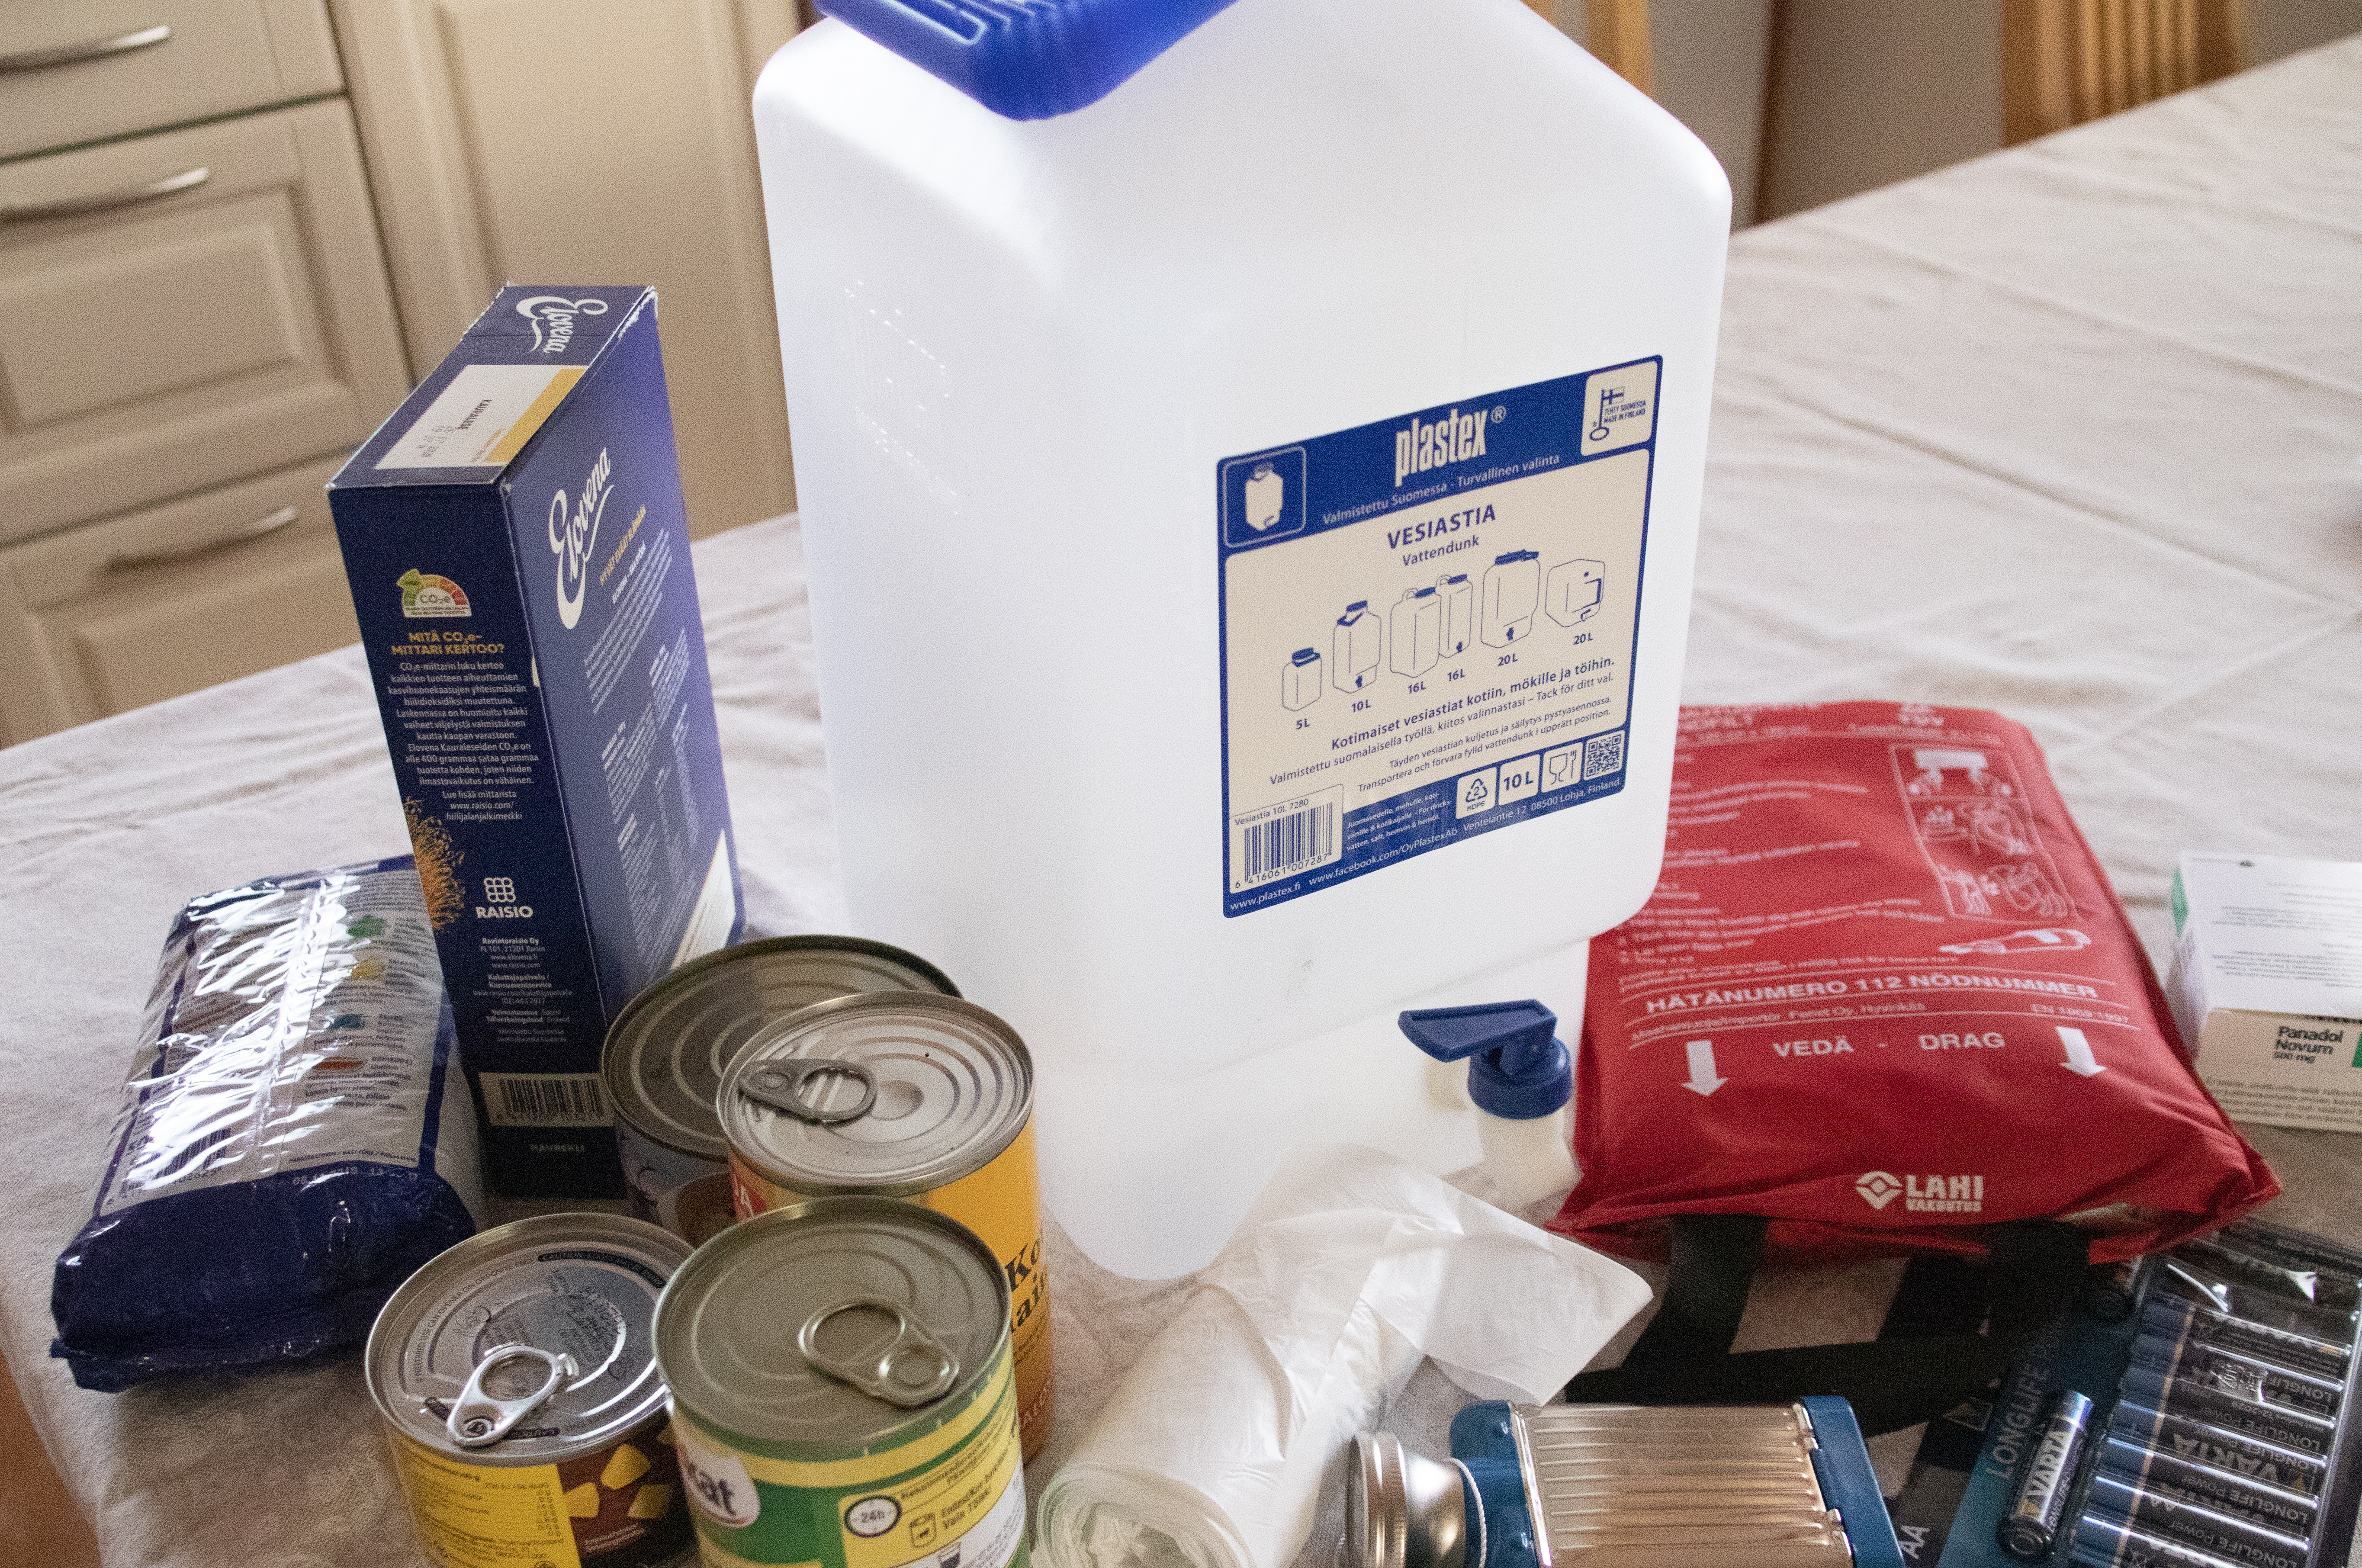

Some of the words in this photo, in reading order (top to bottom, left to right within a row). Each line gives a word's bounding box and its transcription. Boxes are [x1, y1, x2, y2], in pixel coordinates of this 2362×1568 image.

[1604, 415, 1617, 423] MADE
[1625, 408, 1645, 419] FINLAND
[1394, 408, 1488, 488] plastex
[1323, 498, 1388, 524] Valmistettu
[1391, 482, 1447, 505] Suomessa
[1457, 463, 1519, 488] Turvallinen
[1522, 453, 1560, 472] valinta
[1387, 504, 1496, 549] VESIASTIA
[1402, 535, 1479, 566] Vattendunk
[409, 630, 440, 643] MITÄ
[392, 644, 442, 655] MITTARI
[445, 644, 504, 655] KERTOO?
[457, 662, 475, 670] luku
[478, 662, 504, 670] kertoo
[391, 674, 424, 683] kaikkien
[426, 674, 461, 682] tuotteen
[464, 674, 518, 682] aiheuttamien
[388, 685, 469, 696] kasvihuonekaasujen
[472, 684, 526, 696] yhteismäärän
[404, 697, 463, 706] hiilidioksidiksi
[465, 697, 515, 705] muutettuna.
[1332, 720, 1400, 749] Kotimaiset
[1404, 699, 1463, 725] vesiastiat
[1467, 685, 1506, 706] kotiin,
[1510, 671, 1557, 693] mökille
[1559, 666, 1571, 682] ja
[1575, 654, 1615, 675] töihin.
[397, 709, 446, 718] Laskennassa
[460, 709, 501, 717] huomioitu
[504, 708, 527, 716] kaikki
[404, 720, 433, 729] vaiheet
[435, 720, 470, 730] viljelystä
[472, 720, 526, 728] valmistuksen
[1270, 759, 1330, 784] Valmistettu
[1334, 736, 1401, 765] suomalaisella
[1405, 725, 1435, 742] työllä,
[1438, 716, 1465, 730] kiitos
[1467, 697, 1525, 721] valinnastasi
[1536, 686, 1558, 702] Tack
[1560, 682, 1574, 695] för
[1577, 676, 1594, 691] ditt
[1597, 671, 1613, 685] val.
[1389, 753, 1419, 769] Täyden
[1422, 739, 1463, 757] vesiastian
[1465, 728, 1498, 744] kuljetus
[1501, 724, 1508, 735] ja
[1510, 715, 1542, 730] säilytys
[1544, 695, 1612, 722] pystyasennossa.
[417, 732, 442, 740] kautta
[444, 732, 473, 742] kaupan
[408, 743, 439, 752] Elovena
[441, 743, 497, 751] Kauraleseiden
[1358, 768, 1412, 792] Transportera
[1414, 761, 1430, 773] och
[1432, 752, 1462, 767] förvara
[1464, 744, 1483, 759] fylld
[1485, 729, 1533, 750] vattendunk
[1540, 719, 1572, 735] upprätt
[1574, 708, 1610, 725] position.
[439, 756, 476, 765] grammaa
[501, 755, 539, 764] grammaa
[450, 766, 482, 774] kohden,
[484, 766, 504, 774] joten
[420, 777, 482, 785] ilmastovaikutus
[495, 776, 534, 784] vähäinen.
[450, 801, 514, 810] www.raisio.com/
[1234, 810, 1270, 826] Vesiastia
[1273, 804, 1287, 816] 10L
[1289, 797, 1309, 810] 7280
[1467, 800, 1485, 812] HDPE
[1230, 882, 1300, 911] www.plastex.fi
[1309, 828, 1458, 885] www.facebook.com/OyPlastexAb
[1463, 810, 1514, 831] Ventelantie
[1516, 805, 1526, 816] 12
[1530, 797, 1558, 810] 08500
[1560, 787, 1586, 804] Lohja,
[1588, 778, 1621, 794] Finland.
[1235, 880, 1240, 889] 6
[1249, 868, 1286, 884] 416061
[1291, 855, 1327, 871] 007287
[476, 906, 533, 919] RAISIO
[1646, 980, 1848, 1013] HÄTÄNUMERO
[1855, 976, 1902, 991] 112
[1909, 973, 2098, 997] NÖDNUMMER
[2031, 1003, 2054, 1014] EN
[2278, 1025, 2343, 1042] Panadol
[1773, 1036, 1854, 1057] VEDÄ
[1919, 1032, 2005, 1050] DRAG
[2275, 1039, 2333, 1054] Novum
[2274, 1051, 2292, 1060] 500
[2296, 1054, 2315, 1064] mg
[1983, 1363, 2051, 1481] LONGLIFE
[2243, 1418, 2321, 1452] LONGLIFE
[2025, 1426, 2073, 1502] VARTA
[2169, 1433, 2282, 1483] VARTA
[2180, 1473, 2227, 1497] Power
[2228, 1490, 2308, 1523] LONGLIFE
[2167, 1520, 2215, 1545] Power
[2216, 1536, 2298, 1568] LONGLIFE
